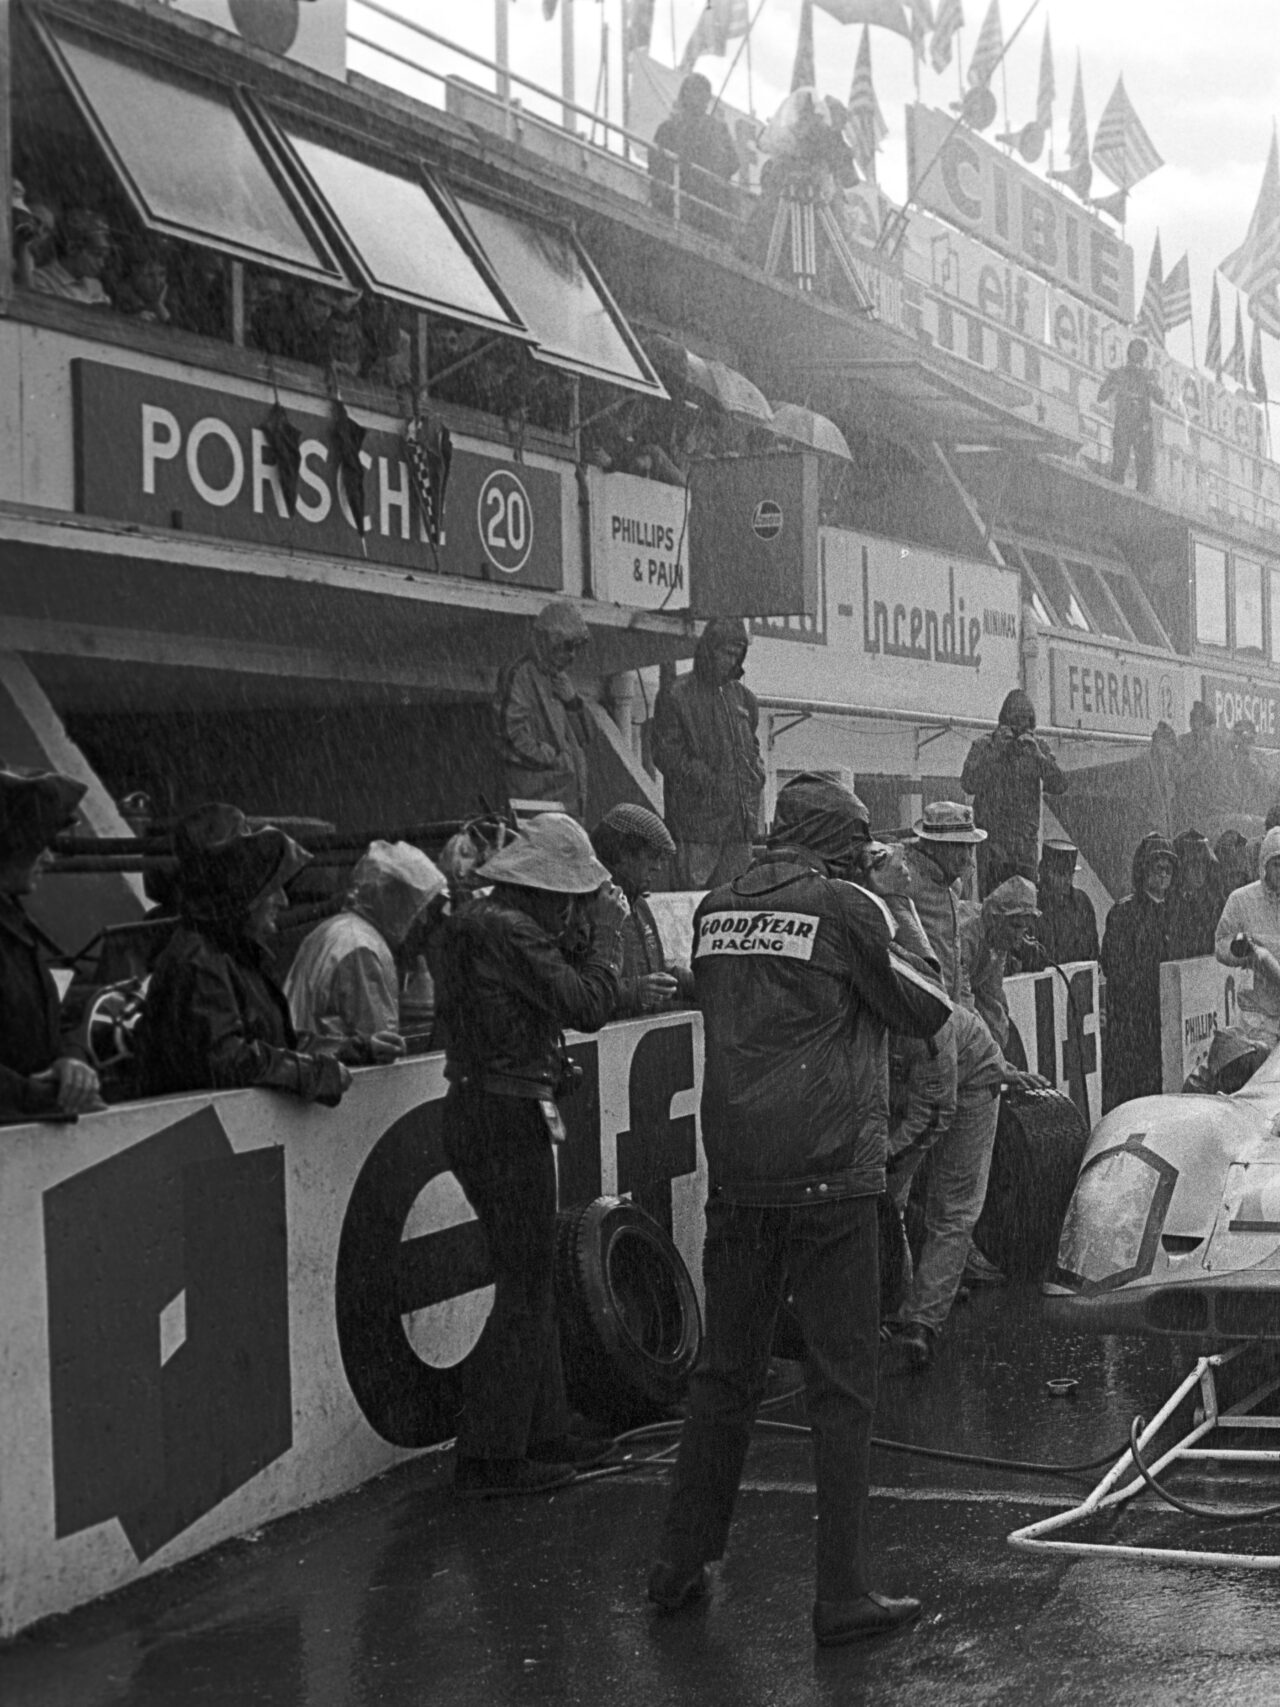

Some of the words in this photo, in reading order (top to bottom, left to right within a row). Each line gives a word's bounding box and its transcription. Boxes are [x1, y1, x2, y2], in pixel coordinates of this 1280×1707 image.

[141, 403, 447, 546] PORSCH
[486, 487, 526, 551] 20
[611, 515, 675, 551] PHILLIPS
[633, 558, 643, 582] &
[648, 558, 684, 590] PAIN
[861, 545, 982, 667] Incendie
[1069, 665, 1150, 720] FERRARI
[1215, 690, 1275, 734] PORSCHE
[712, 938, 783, 951] RACING
